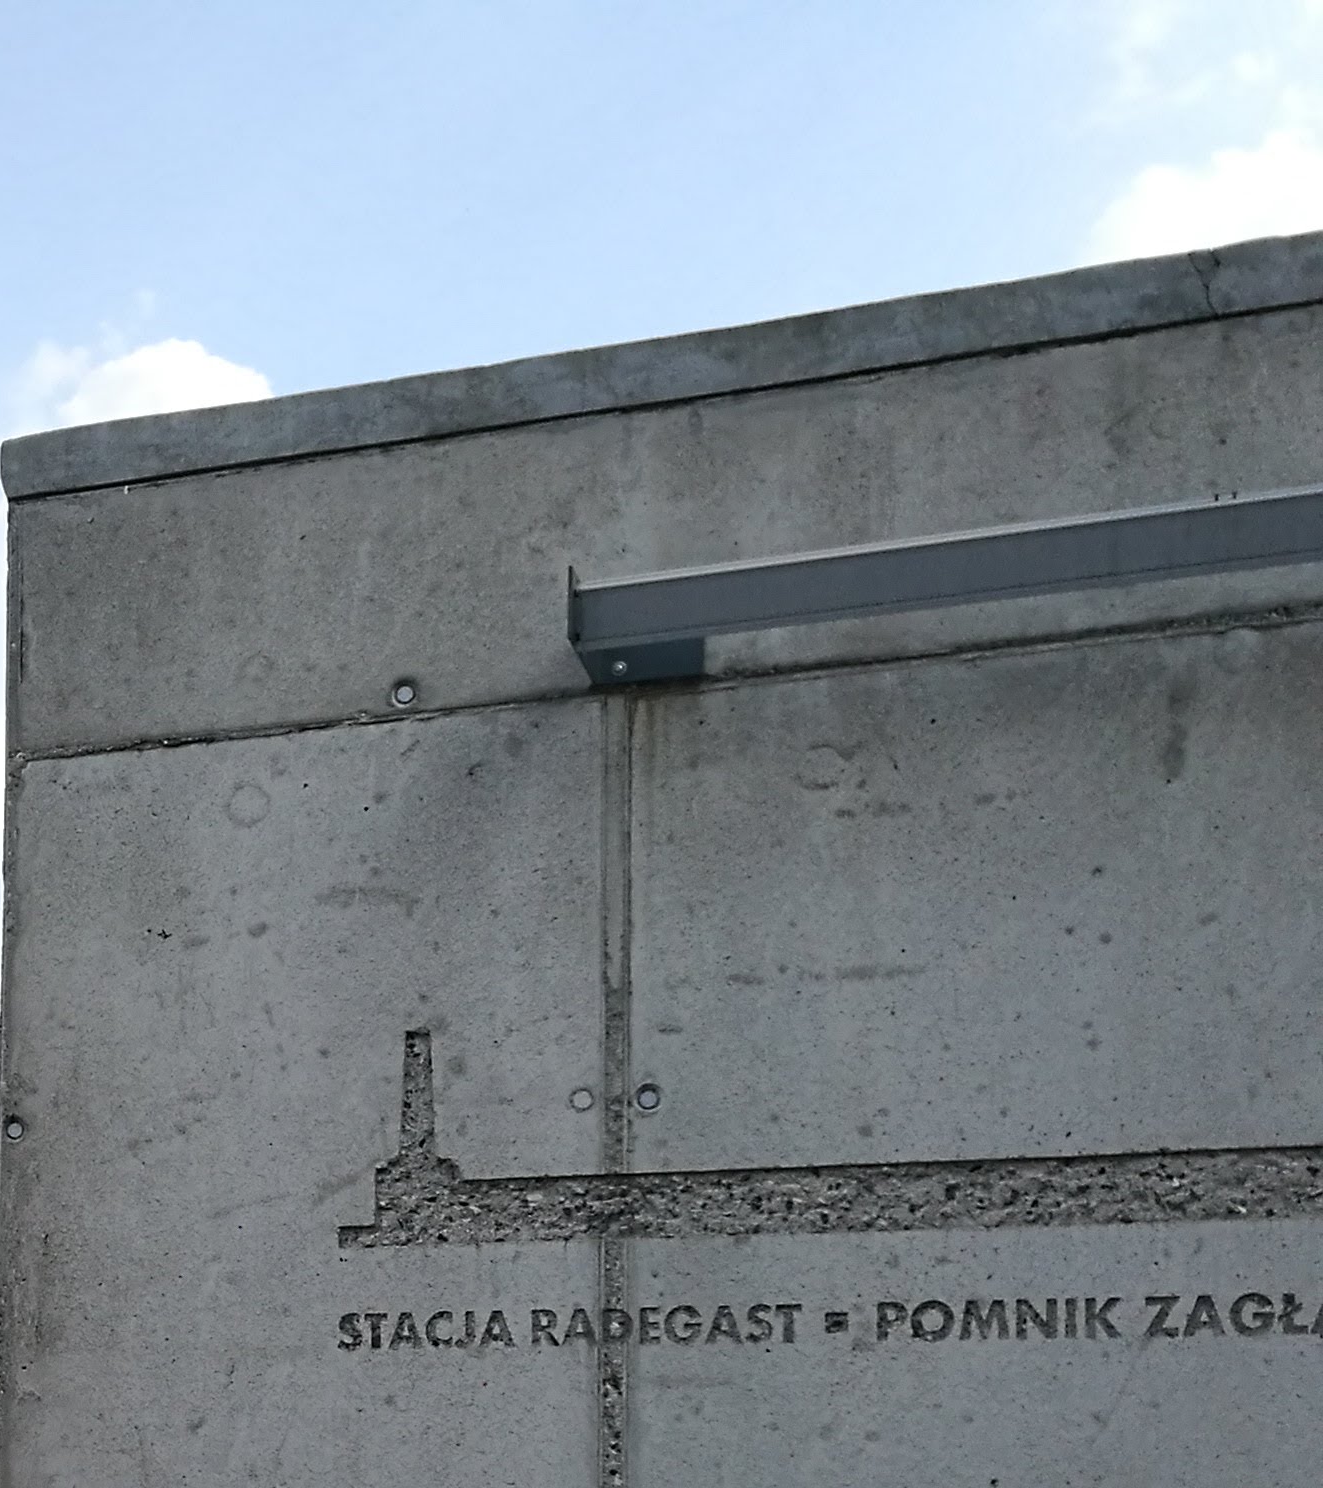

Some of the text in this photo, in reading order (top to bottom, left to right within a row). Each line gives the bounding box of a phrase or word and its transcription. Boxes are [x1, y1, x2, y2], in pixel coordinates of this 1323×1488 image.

[337, 1310, 518, 1351] STACJA
[530, 1303, 803, 1348] RADEGAST
[876, 1297, 1122, 1343] POMNIK
